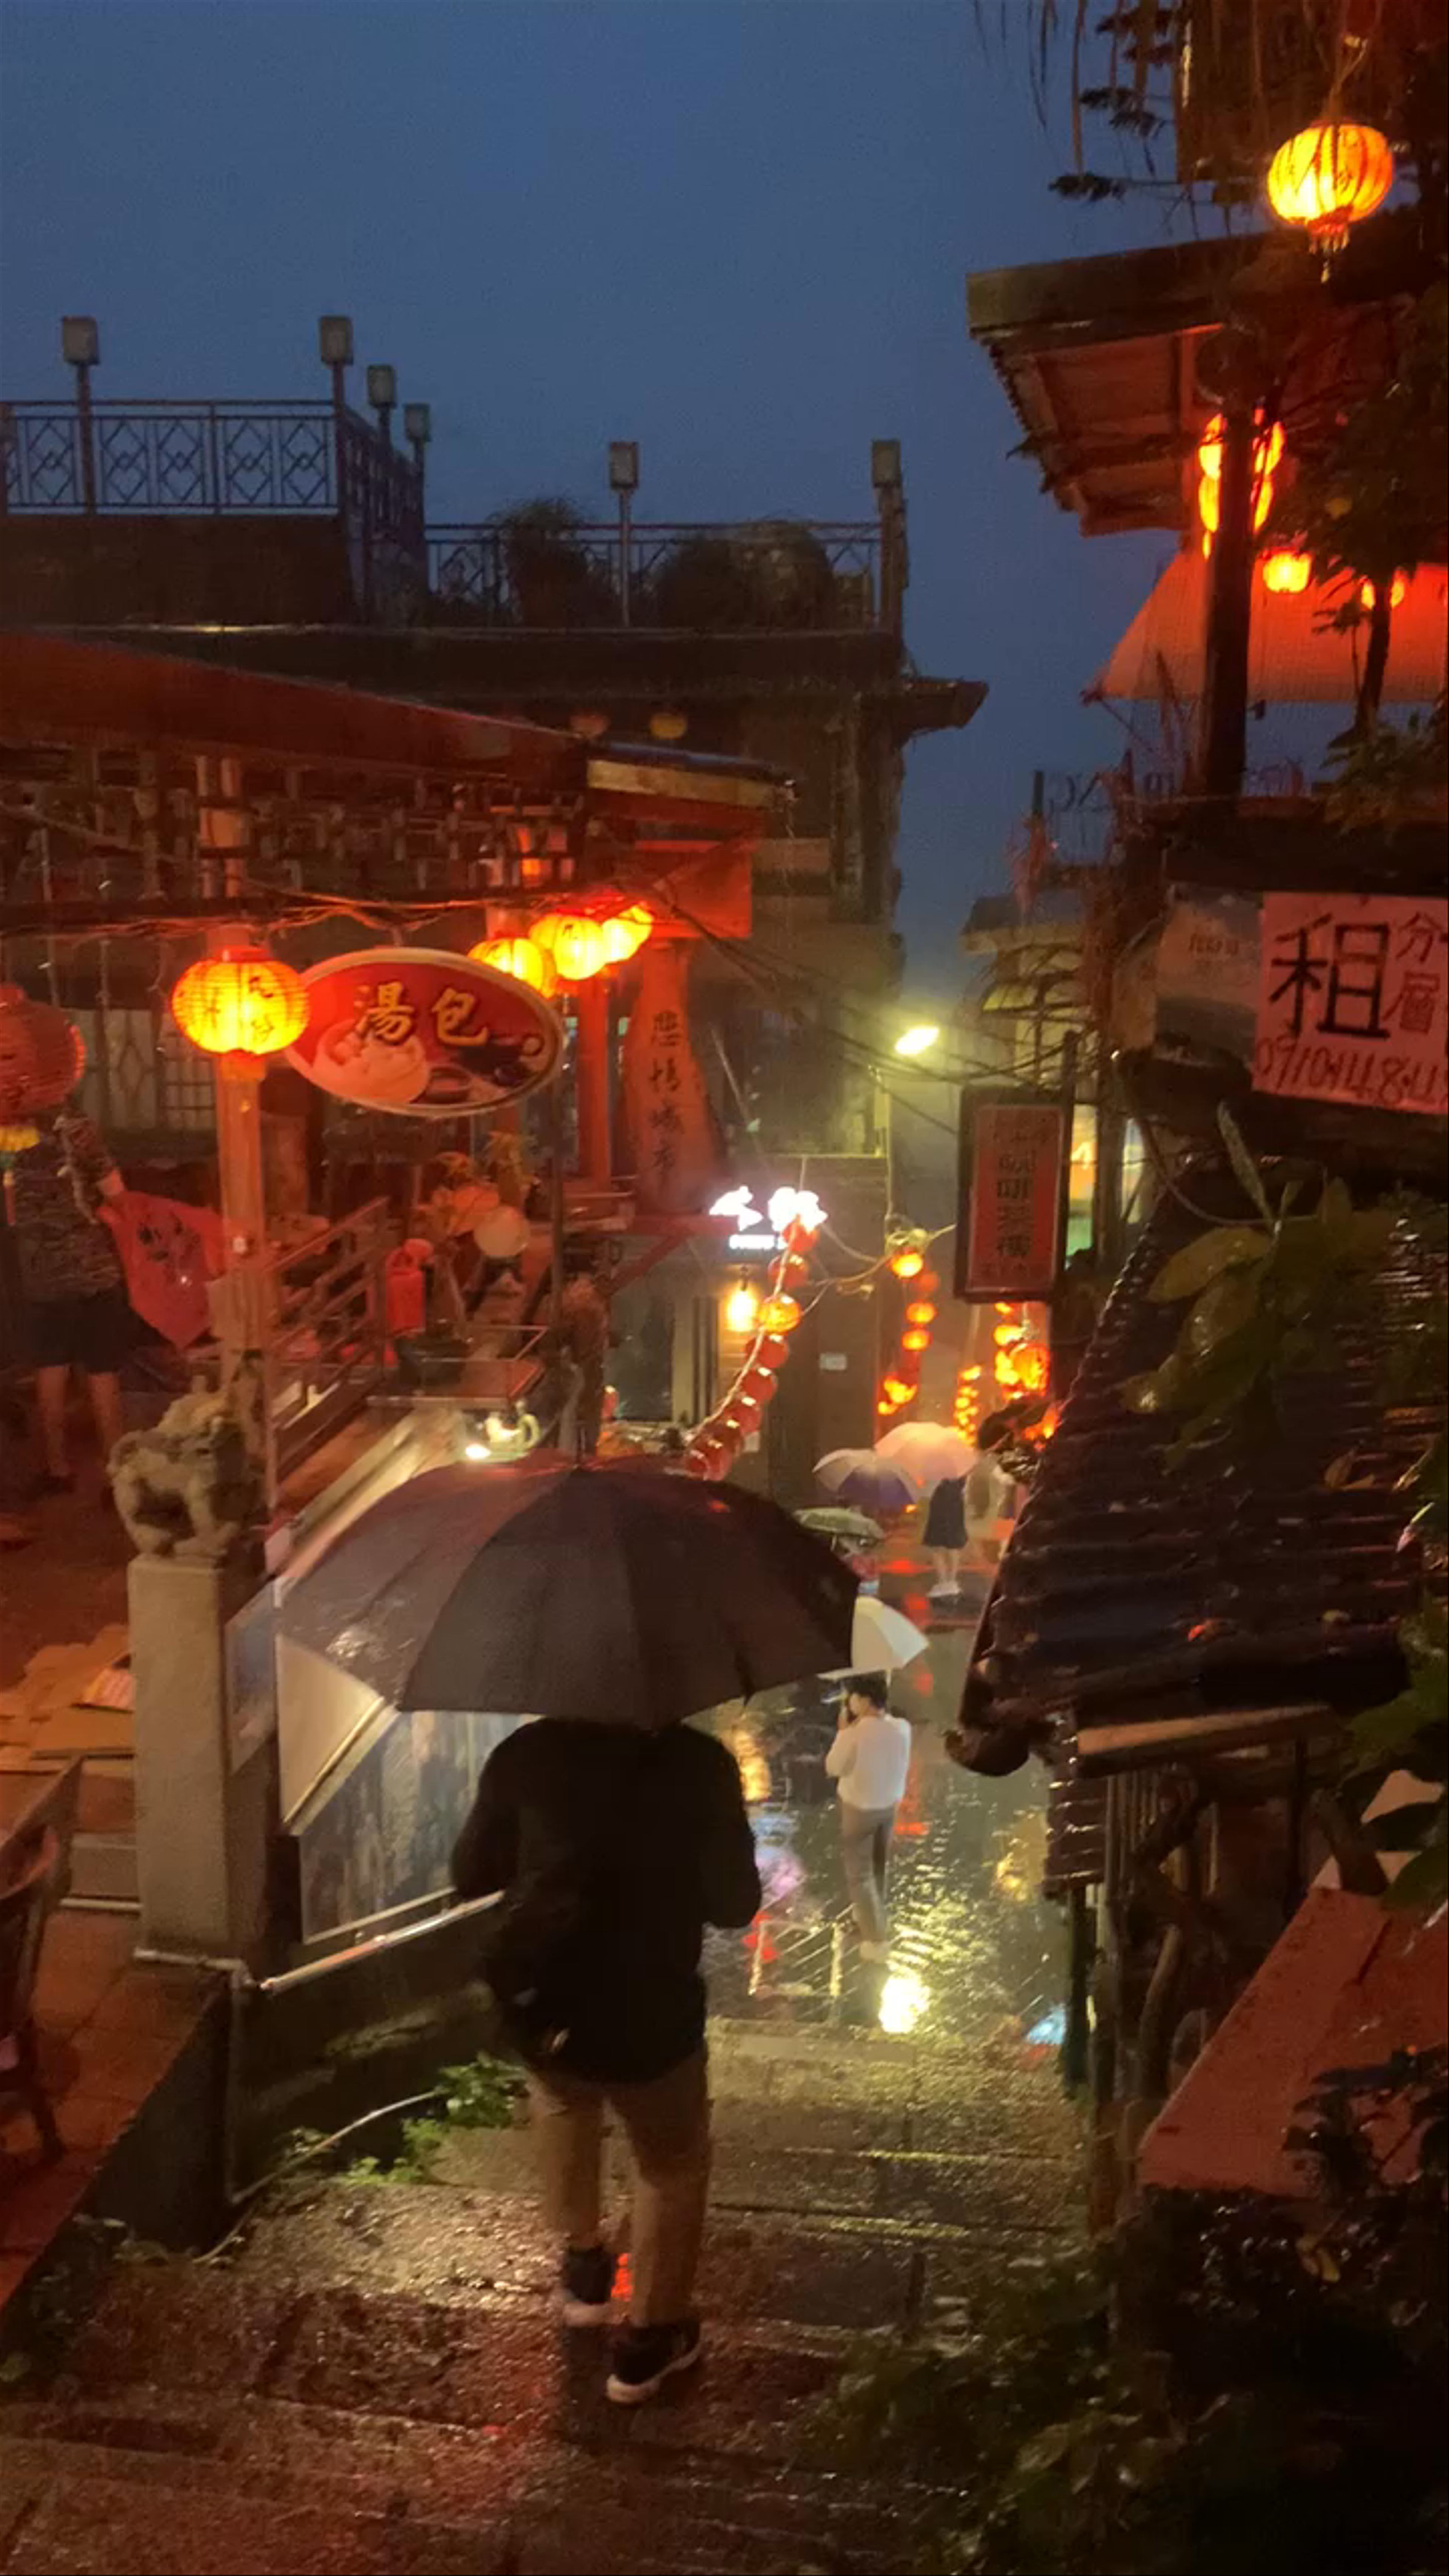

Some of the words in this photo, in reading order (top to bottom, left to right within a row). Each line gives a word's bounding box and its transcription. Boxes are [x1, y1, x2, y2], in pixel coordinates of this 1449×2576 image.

[353, 981, 489, 1046] 湯包
[1268, 912, 1391, 1041] 租
[1382, 912, 1441, 1035] 分層
